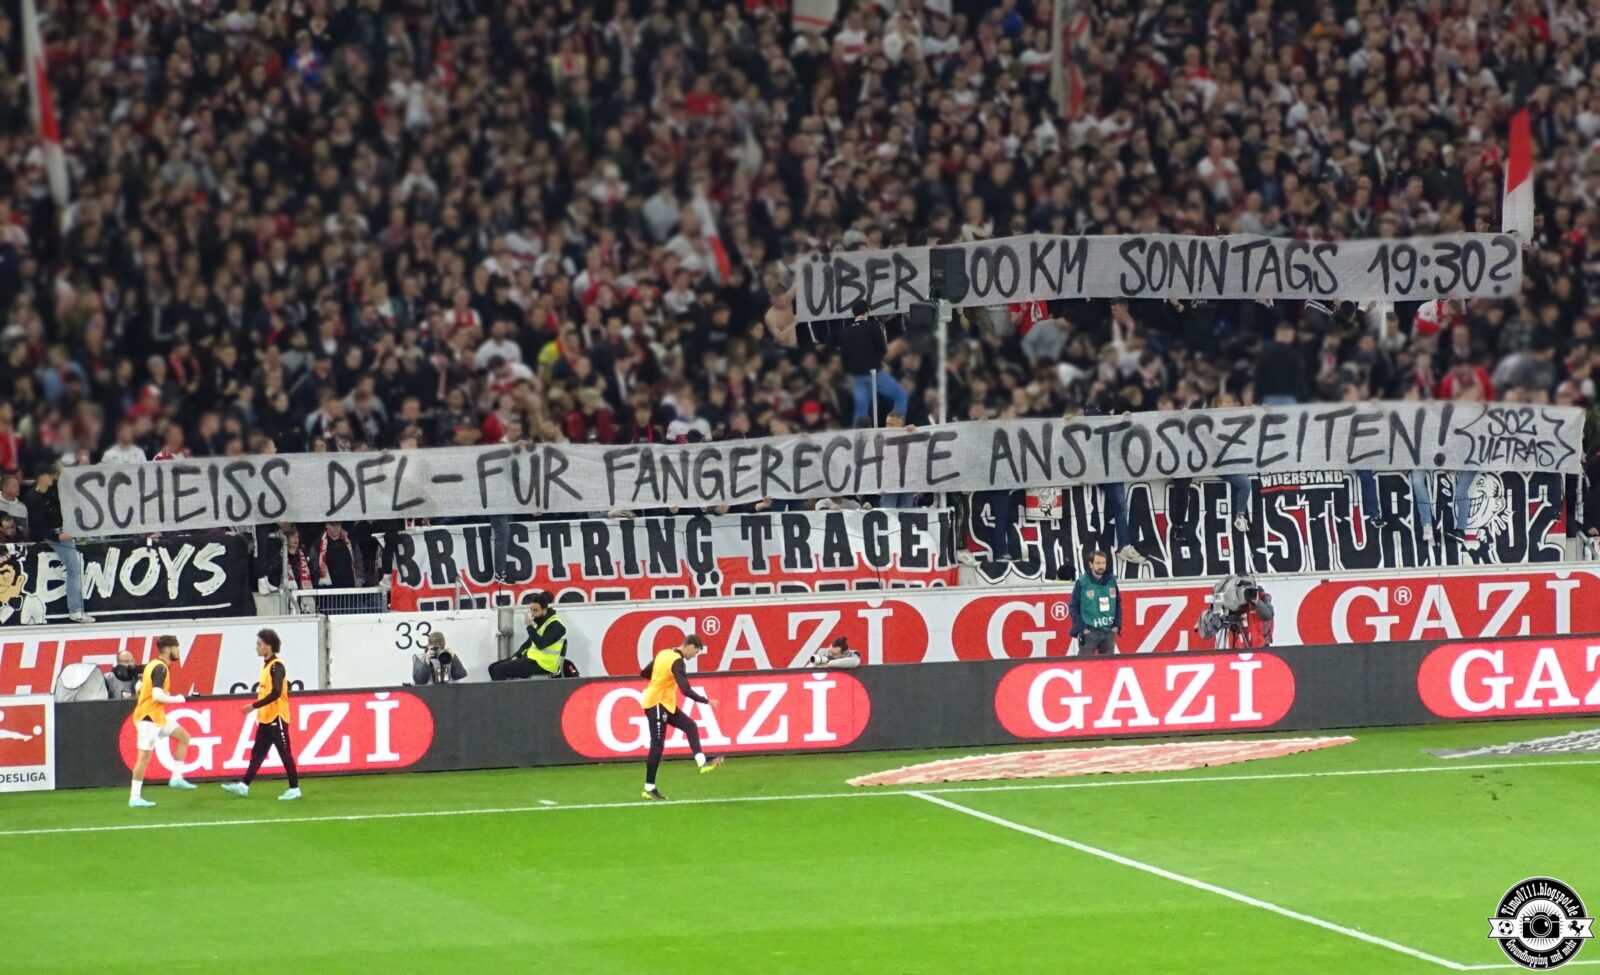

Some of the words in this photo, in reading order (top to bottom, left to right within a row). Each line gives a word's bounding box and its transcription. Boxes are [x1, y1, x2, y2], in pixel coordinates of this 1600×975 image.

[803, 252, 929, 317] ÜBER
[1119, 237, 1339, 296] SONNTAGS
[1368, 235, 1518, 296] 19:30?
[74, 457, 290, 531] SCHEISS
[603, 428, 961, 507] FANGERECHTE
[990, 402, 1454, 486] ANSTOSSZEITEN!
[1479, 435, 1557, 468] ULTRAS
[394, 514, 715, 587] BRUSTRING
[395, 621, 432, 650] 33
